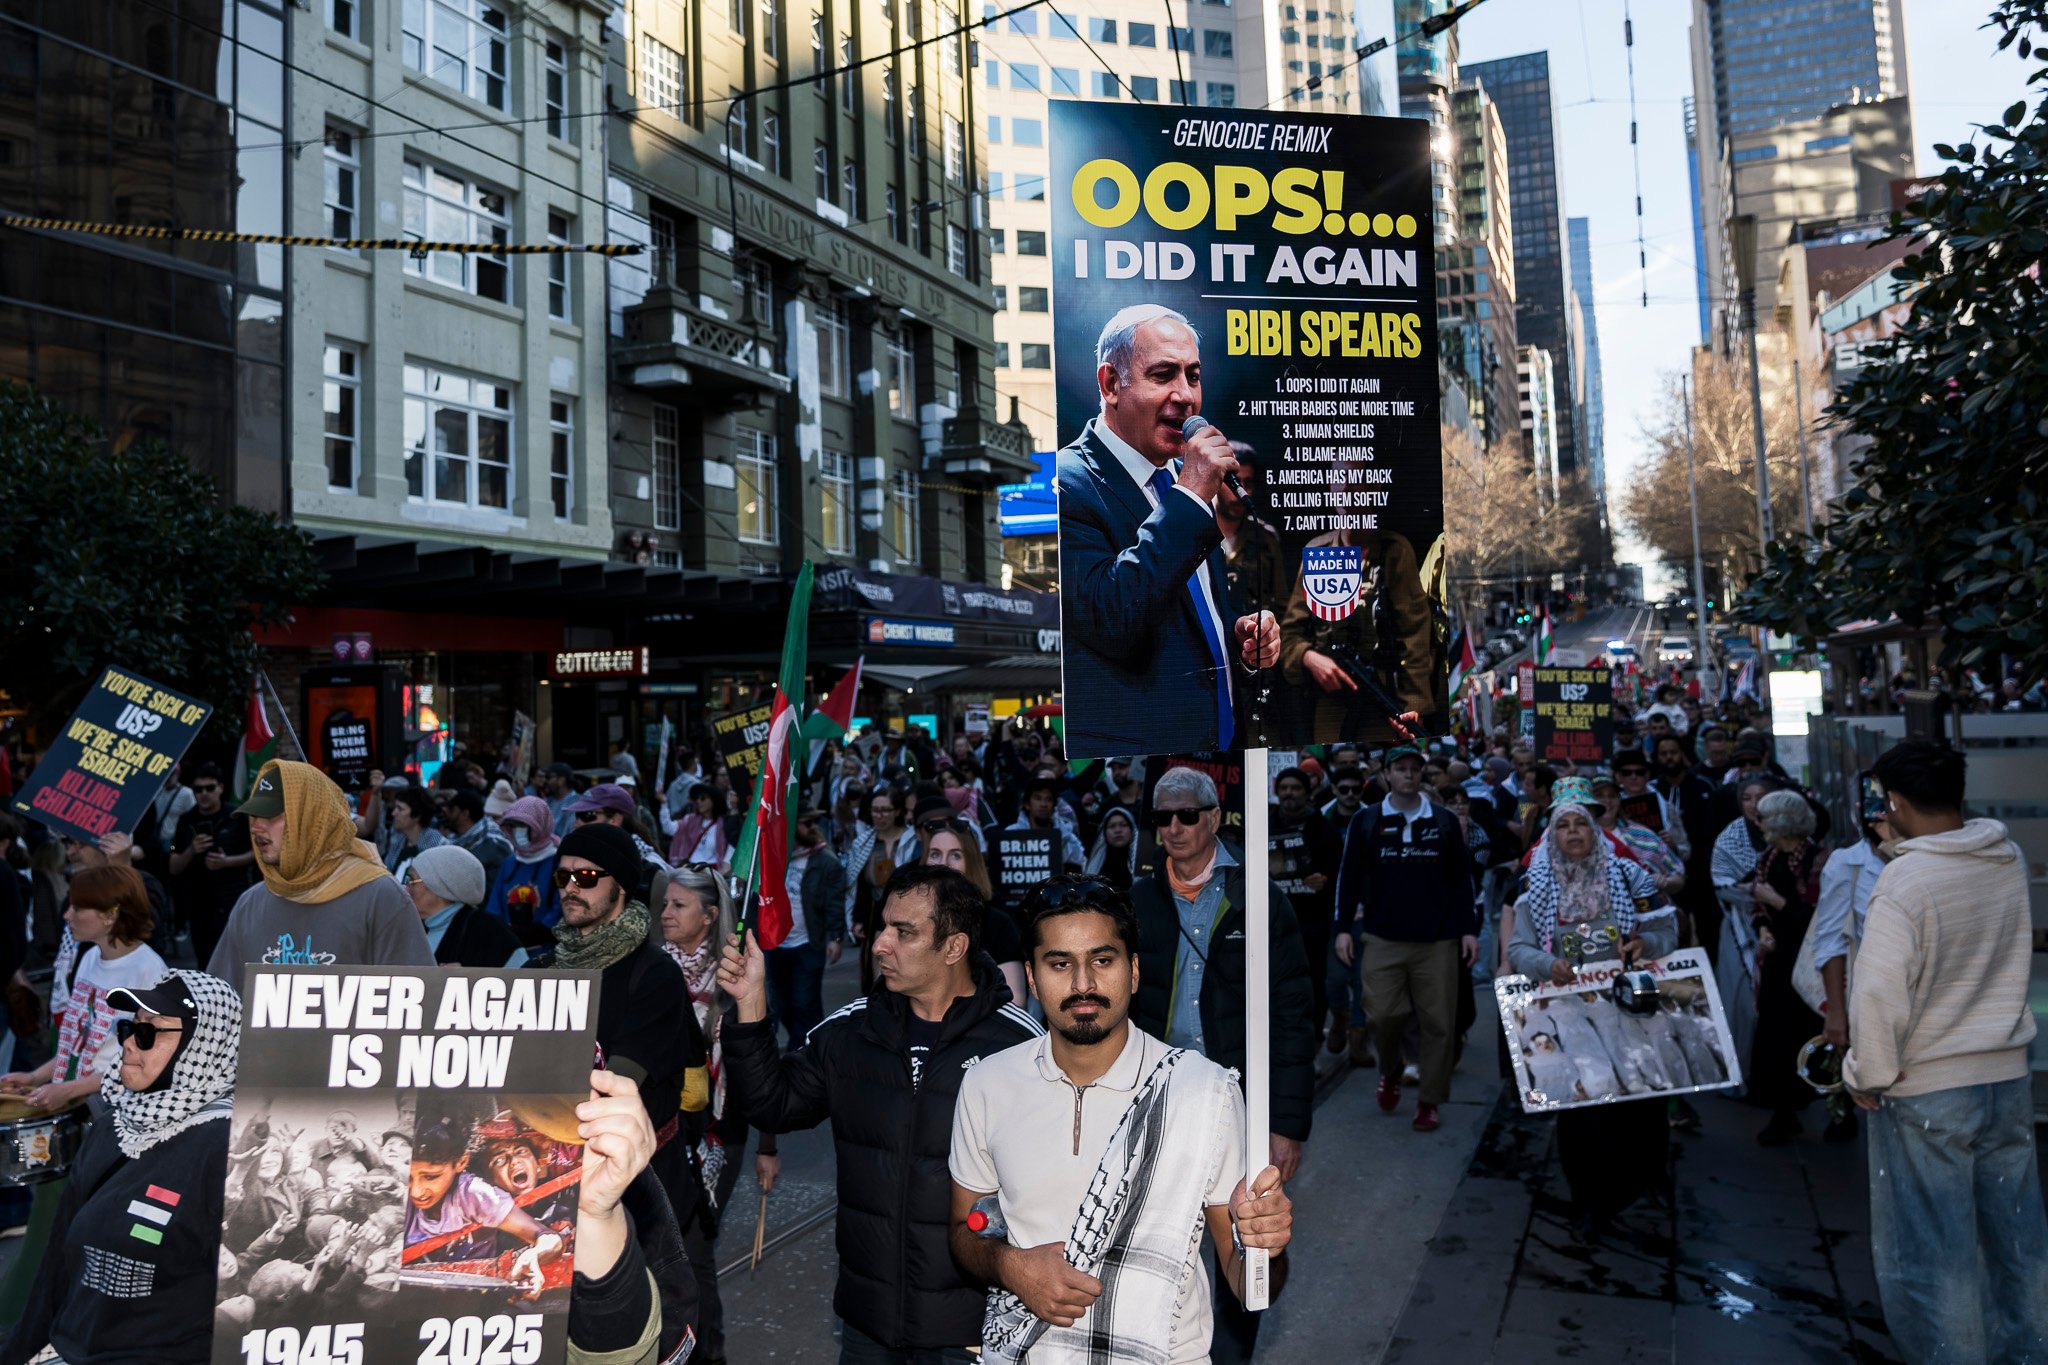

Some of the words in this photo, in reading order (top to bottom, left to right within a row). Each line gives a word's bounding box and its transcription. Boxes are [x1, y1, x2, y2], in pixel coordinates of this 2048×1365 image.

[1173, 119, 1269, 150] GENOCIDE
[1271, 123, 1333, 154] REMIX
[1071, 158, 1418, 239] OOPS!...
[715, 176, 817, 257] LONDON
[830, 238, 909, 300] STORES
[1074, 239, 1088, 278] I
[1104, 240, 1196, 281] DID
[1210, 243, 1255, 283] IT
[1265, 246, 1418, 288] AGAIN
[1226, 309, 1292, 357] BIBI
[1300, 311, 1422, 359] SPEARS
[1275, 378, 1285, 393] 1.
[1286, 378, 1313, 394] OOPS
[1314, 378, 1319, 393] I
[1320, 378, 1337, 393] DID
[1339, 378, 1349, 393] IT
[1350, 378, 1380, 394] AGAIN
[1238, 401, 1249, 416] 2.
[1251, 401, 1267, 416] HIT
[1270, 401, 1300, 416] THEIR
[1302, 401, 1337, 416] BABIES
[1339, 401, 1359, 416] ONE
[1361, 401, 1389, 416] MORE
[1391, 401, 1415, 416] TIME
[1282, 424, 1293, 439] 3.
[1295, 424, 1332, 439] HUMAN
[1333, 424, 1375, 439] SHIELDS
[1284, 447, 1295, 462] 4.
[1296, 447, 1300, 461] I
[1302, 447, 1336, 462] BLAME
[1338, 446, 1374, 462] HAMAS
[1266, 470, 1277, 485] 5.
[1278, 470, 1324, 485] AMERICA
[1326, 470, 1346, 485] HAS
[1348, 469, 1364, 484] MY
[1366, 469, 1393, 484] BACK
[1271, 492, 1282, 508] 6.
[1283, 492, 1322, 508] KILLING
[1324, 492, 1352, 507] THEM
[1353, 491, 1389, 507] SOFTLY
[1284, 516, 1294, 531] 7.
[1296, 515, 1326, 531] CAN'T
[1327, 515, 1361, 530] TOUCH
[1363, 515, 1378, 530] ME
[1307, 560, 1343, 571] MADE
[1345, 558, 1358, 570] IN
[1313, 578, 1353, 595] USA
[101, 670, 153, 705] YOU'RE
[150, 690, 186, 720] SICK
[180, 704, 206, 726] OF
[1560, 683, 1589, 701] US?
[115, 703, 163, 739] US?
[331, 735, 366, 748] THEM
[743, 721, 770, 745] US?
[67, 717, 118, 752] WE'RE
[113, 738, 153, 769] SICK
[146, 753, 174, 776] OF
[331, 746, 368, 760] HOME
[56, 768, 122, 811] KILLING
[1000, 839, 1050, 853] BRING
[1001, 854, 1049, 868] THEM
[1668, 959, 1699, 971] GAZA
[1506, 980, 1539, 995] STOP
[251, 974, 426, 1030] NEVER
[434, 977, 591, 1032] AGAIN
[328, 1034, 384, 1088] IS
[396, 1035, 514, 1089] NOW
[241, 1323, 365, 1365] 1945
[416, 1314, 544, 1365] 2025
